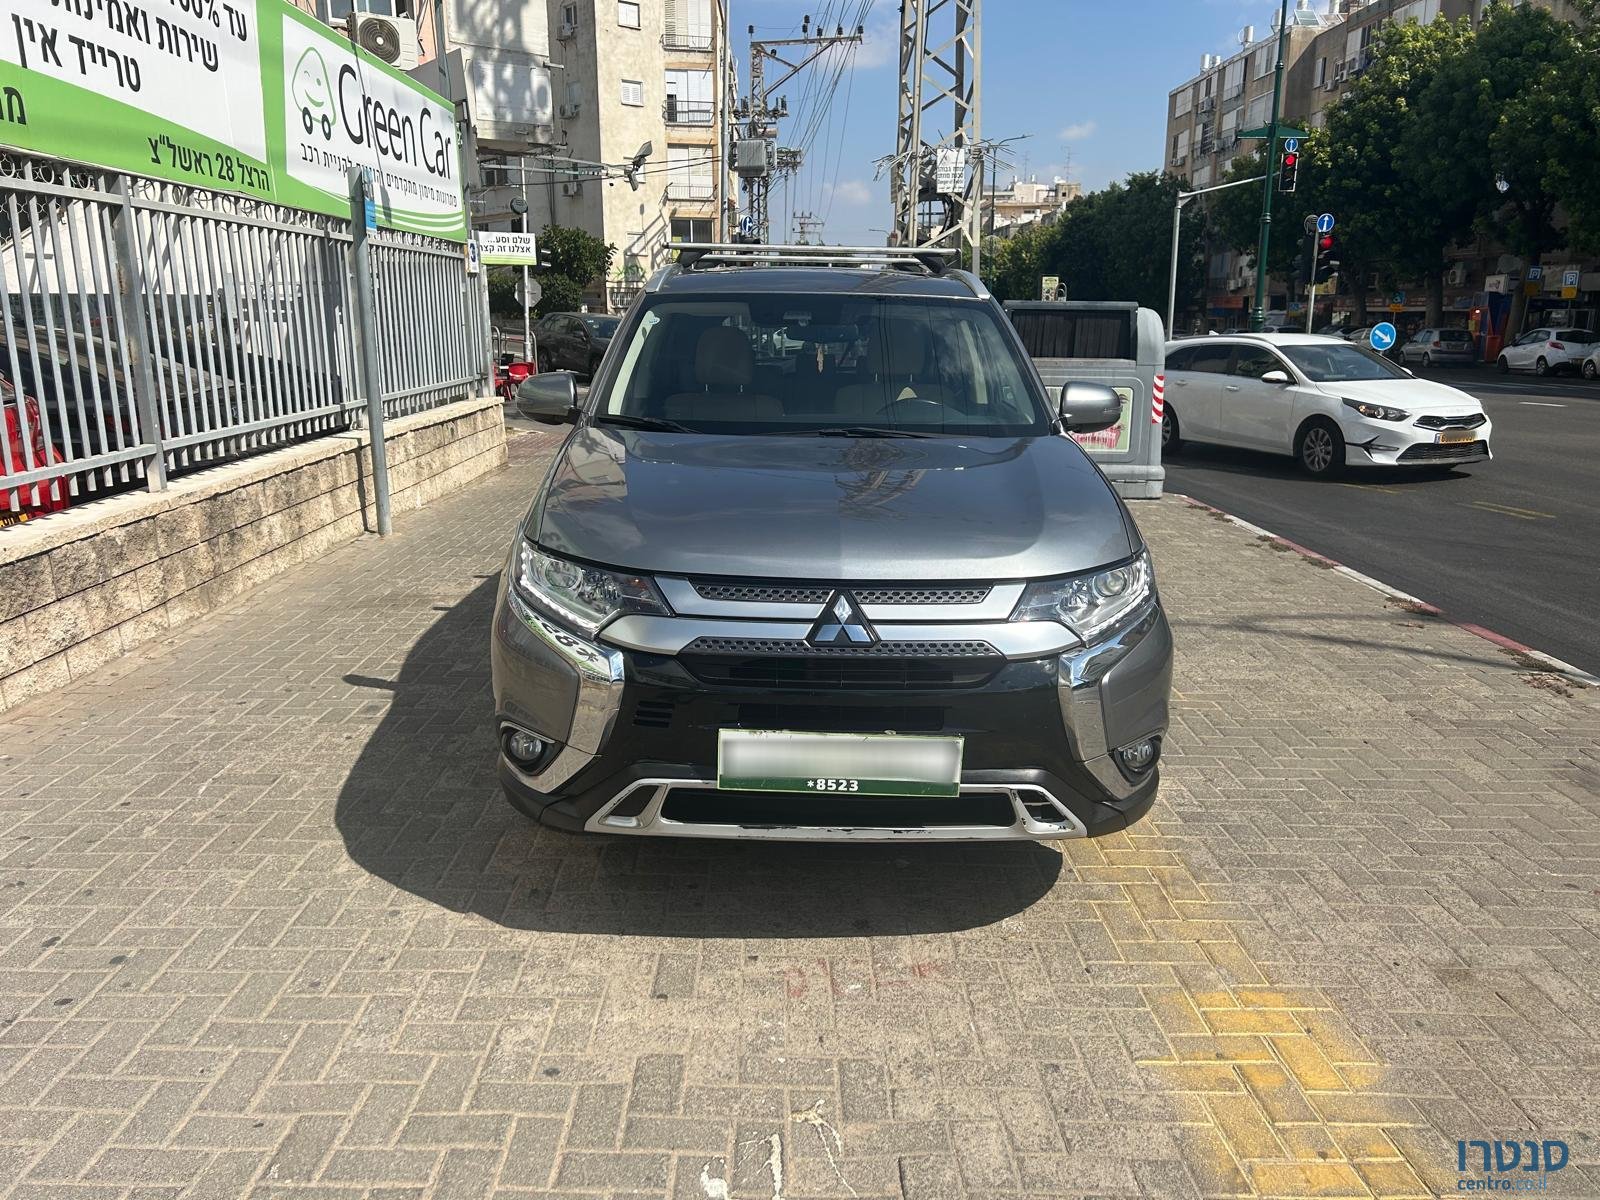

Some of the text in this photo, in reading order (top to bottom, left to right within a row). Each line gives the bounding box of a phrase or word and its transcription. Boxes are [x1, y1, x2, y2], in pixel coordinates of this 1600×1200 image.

[51, 0, 219, 72] שירות ואמנ
[170, 0, 247, 41] עד 0%
[11, 13, 141, 92] טרייד אין
[338, 64, 451, 180] Green Car
[215, 153, 235, 182] 28
[301, 143, 320, 165] רכב
[236, 157, 270, 191] הרצל
[386, 173, 418, 196] מתקדמים
[508, 244, 531, 253] אצלנו
[512, 236, 531, 244] שלם
